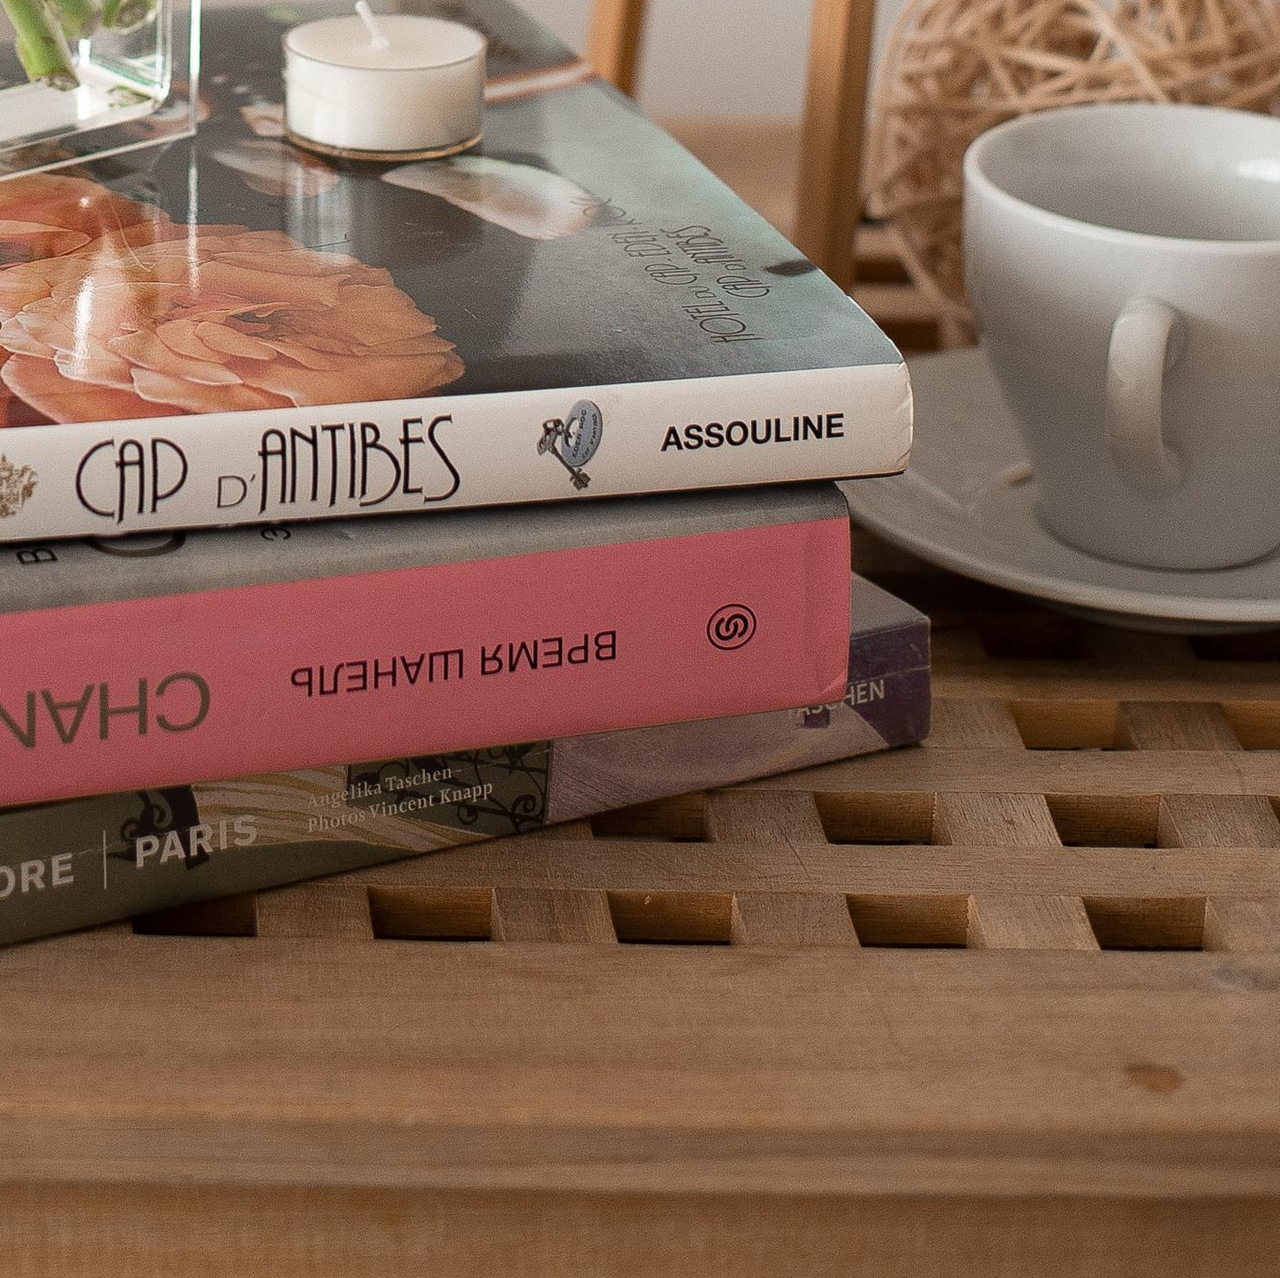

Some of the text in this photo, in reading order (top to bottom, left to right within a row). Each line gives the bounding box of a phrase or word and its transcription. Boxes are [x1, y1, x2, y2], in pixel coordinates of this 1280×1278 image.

[606, 230, 672, 258] EDEN
[644, 263, 701, 286] CAP
[716, 275, 772, 298] CAP
[681, 300, 765, 343] HOTEL
[660, 412, 845, 452] ASSOULINE
[75, 414, 461, 525] CAP D'ANTIBES
[290, 630, 617, 697] ВРЕМЯ ШАНЕЛЬ
[307, 781, 382, 809] Angelika
[308, 782, 494, 833] Photos Vincent Knapp
[134, 814, 259, 869] PARIS
